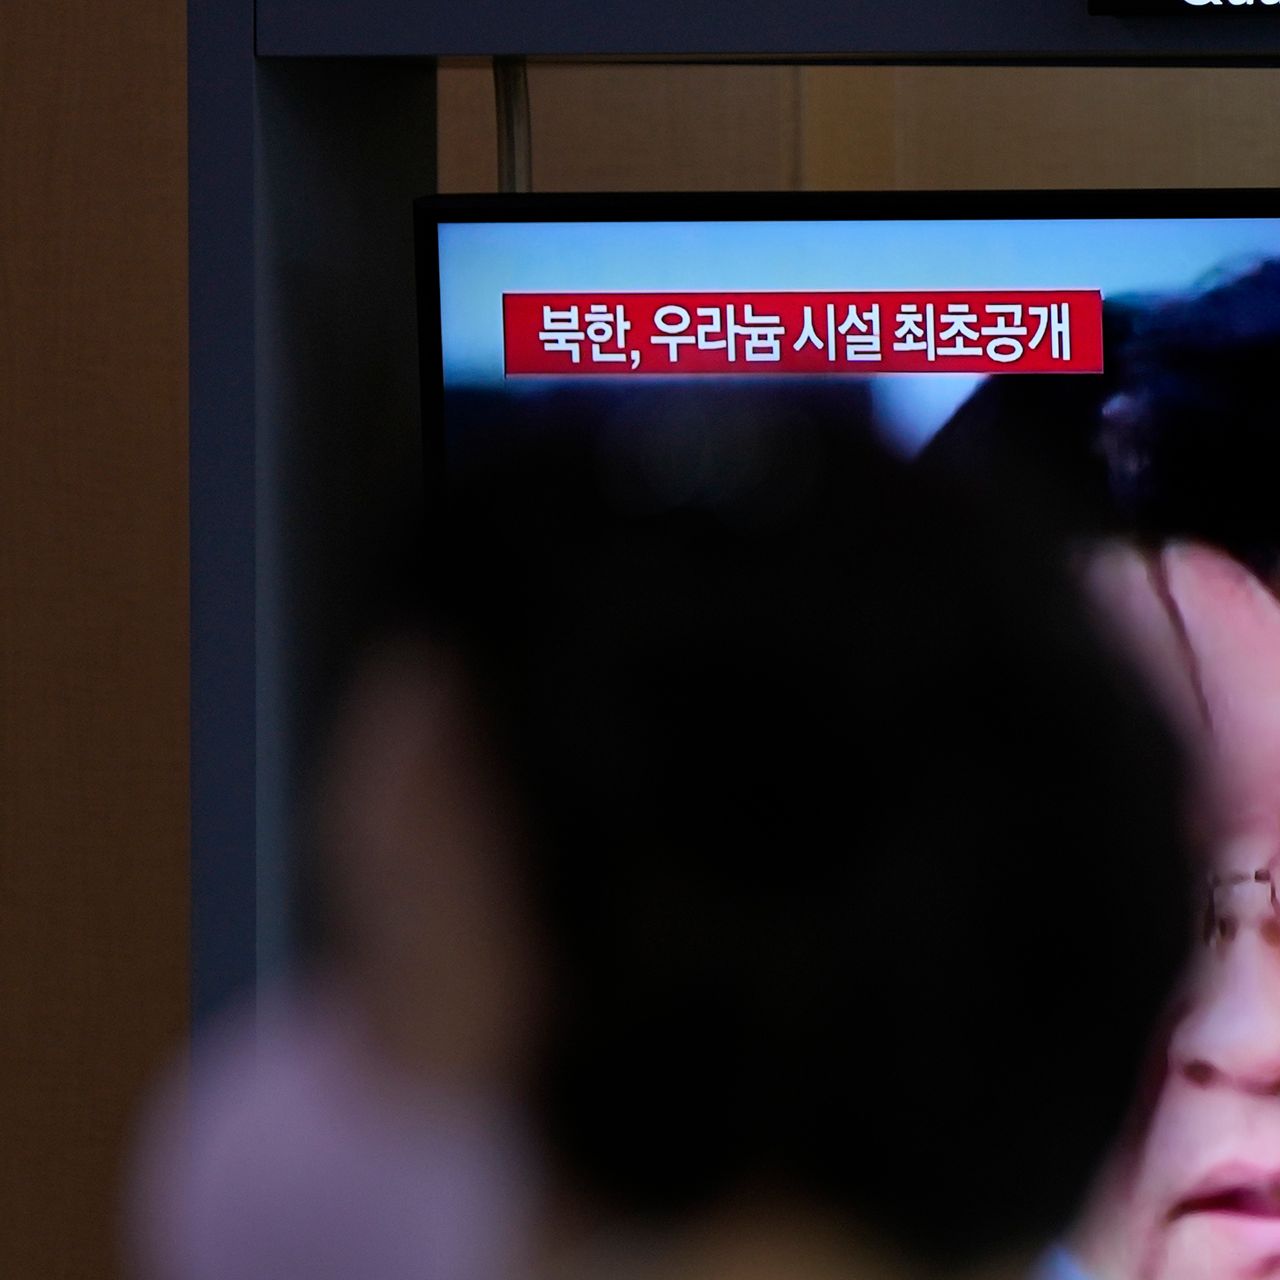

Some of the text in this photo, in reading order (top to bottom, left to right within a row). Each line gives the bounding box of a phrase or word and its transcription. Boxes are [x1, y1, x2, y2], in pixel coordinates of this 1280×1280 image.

[538, 302, 1071, 369] 북한, 우라늄 시설 최초공개
